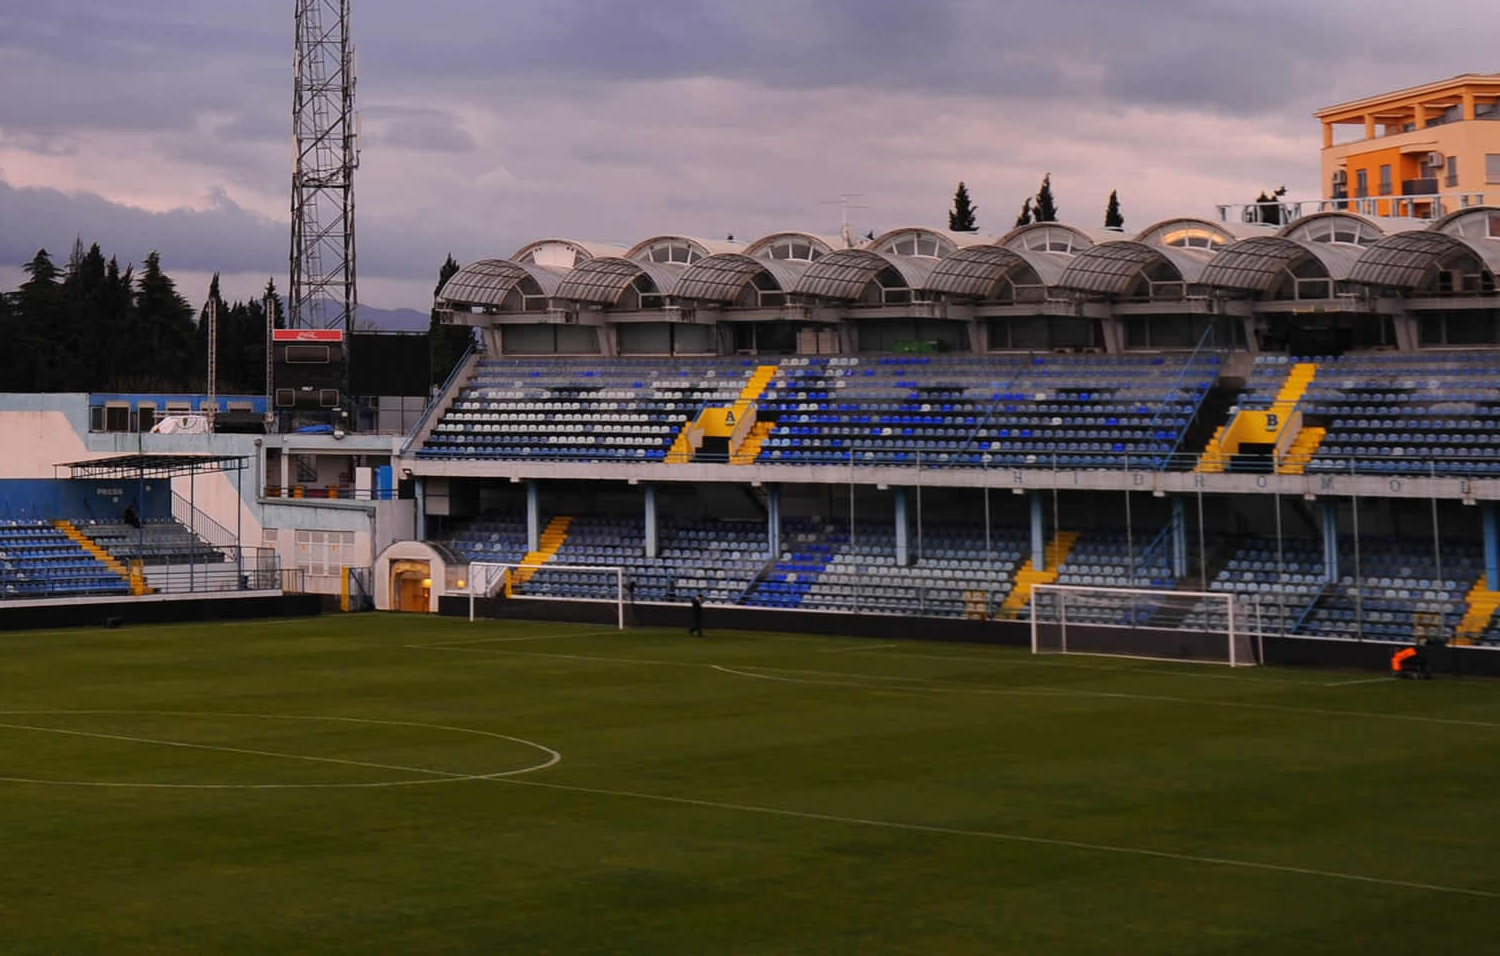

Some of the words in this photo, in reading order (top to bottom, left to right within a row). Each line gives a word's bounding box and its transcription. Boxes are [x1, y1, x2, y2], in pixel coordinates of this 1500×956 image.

[725, 411, 736, 423] A
[1266, 414, 1278, 426] B
[97, 488, 124, 496] PRESS
